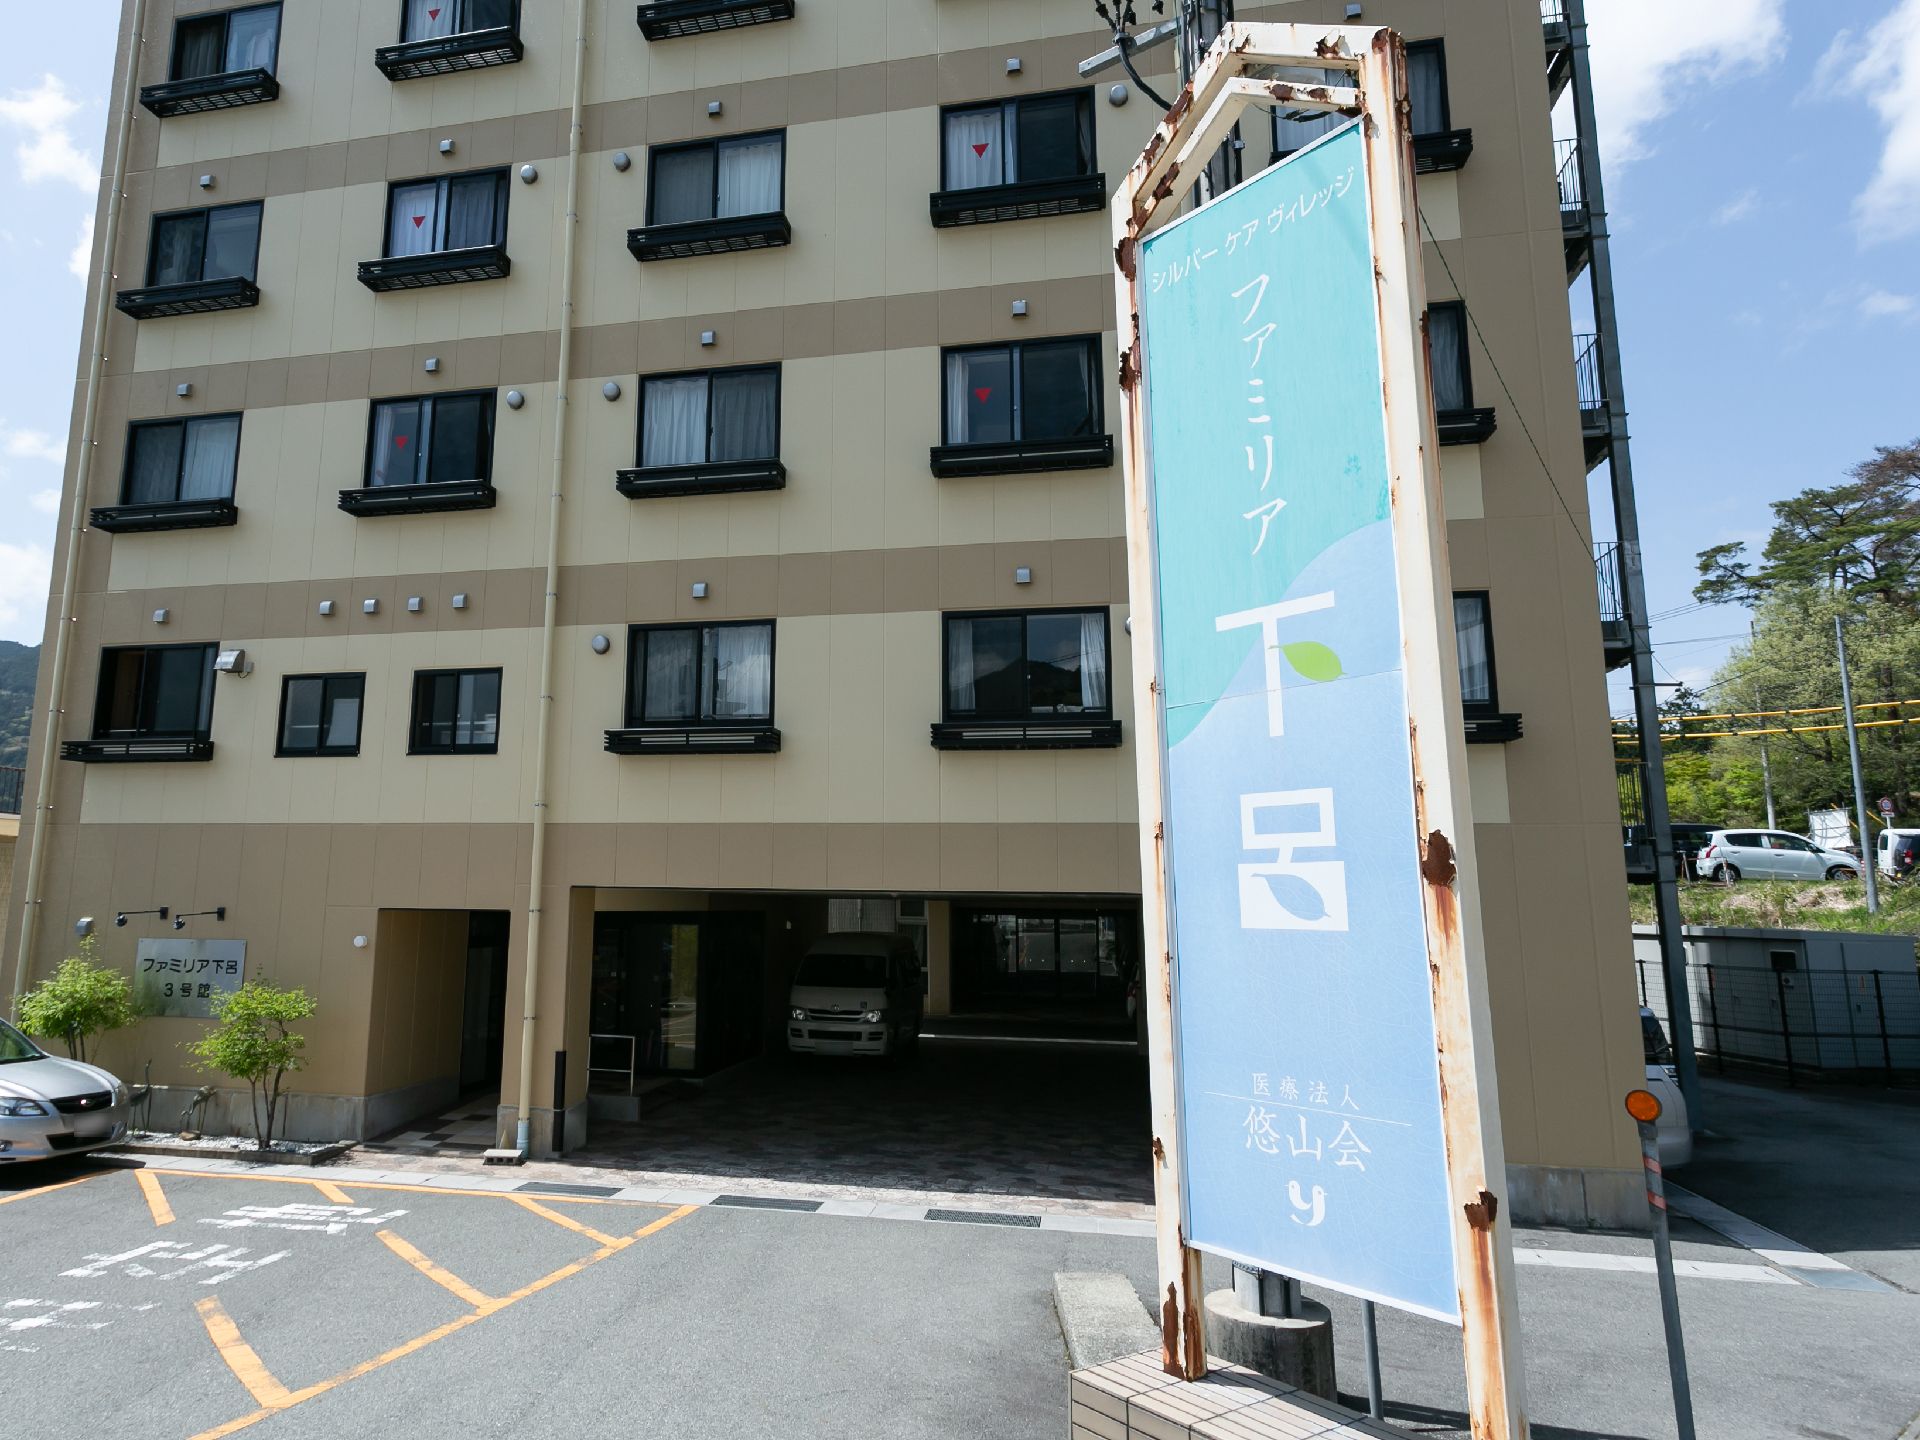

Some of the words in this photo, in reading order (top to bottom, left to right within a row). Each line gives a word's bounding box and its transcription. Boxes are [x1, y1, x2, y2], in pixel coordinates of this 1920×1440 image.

[1152, 247, 1218, 293] シルバー
[1225, 218, 1259, 256] ケア
[1267, 166, 1355, 234] ヴィレッジ
[1231, 274, 1287, 556] ファミリア
[1215, 590, 1349, 932] 下呂
[143, 958, 238, 975] ファミリア下呂
[1242, 1105, 1372, 1172] 悠山会
[1252, 1072, 1360, 1111] 医療法人
